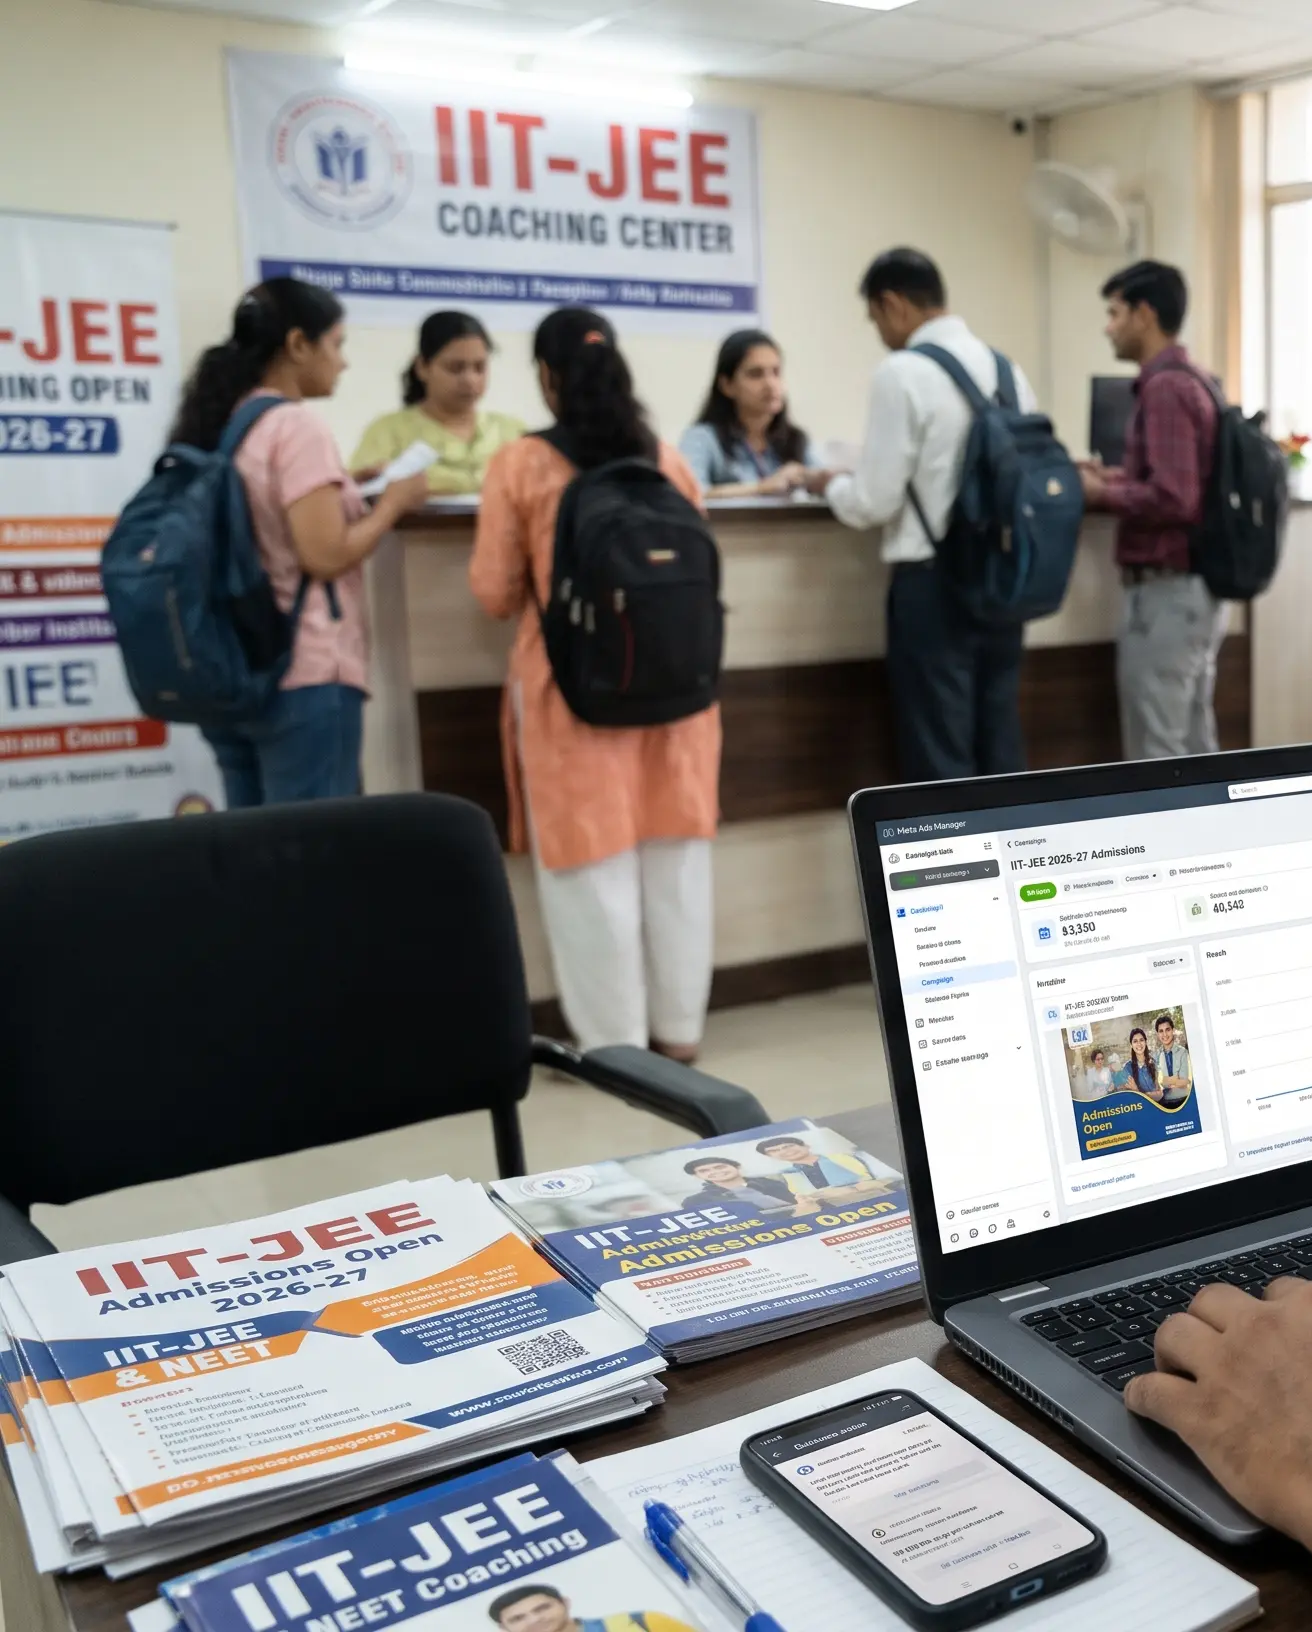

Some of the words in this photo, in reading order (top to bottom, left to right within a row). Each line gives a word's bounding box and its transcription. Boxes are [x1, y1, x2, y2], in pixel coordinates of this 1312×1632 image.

[434, 105, 732, 209] IIT-JEE
[438, 201, 608, 247] COACHING
[620, 214, 735, 254] CENTER
[0, 375, 60, 402] ING
[70, 376, 151, 404] OPEN
[896, 826, 918, 835] Meta
[918, 824, 933, 833] Ads
[1010, 856, 1047, 871] IIT-JEE
[1091, 843, 1146, 860] Admissions
[1081, 1101, 1143, 1123] Admissions
[1083, 1121, 1113, 1136] Open
[75, 1201, 437, 1297] IIT-JEE
[573, 1206, 738, 1250] IIT-JEE
[619, 1222, 813, 1274] Admissions
[815, 1200, 898, 1228] Open
[98, 1257, 336, 1316] Admissions
[344, 1231, 444, 1263] Open
[210, 1267, 368, 1314] 2026-27
[103, 1321, 263, 1368] IIT-JEE
[114, 1367, 152, 1389] &
[158, 1340, 275, 1379] NEET
[231, 1482, 566, 1632] IIT-JEE
[304, 1588, 405, 1632] NEET
[415, 1526, 589, 1601] Coaching
